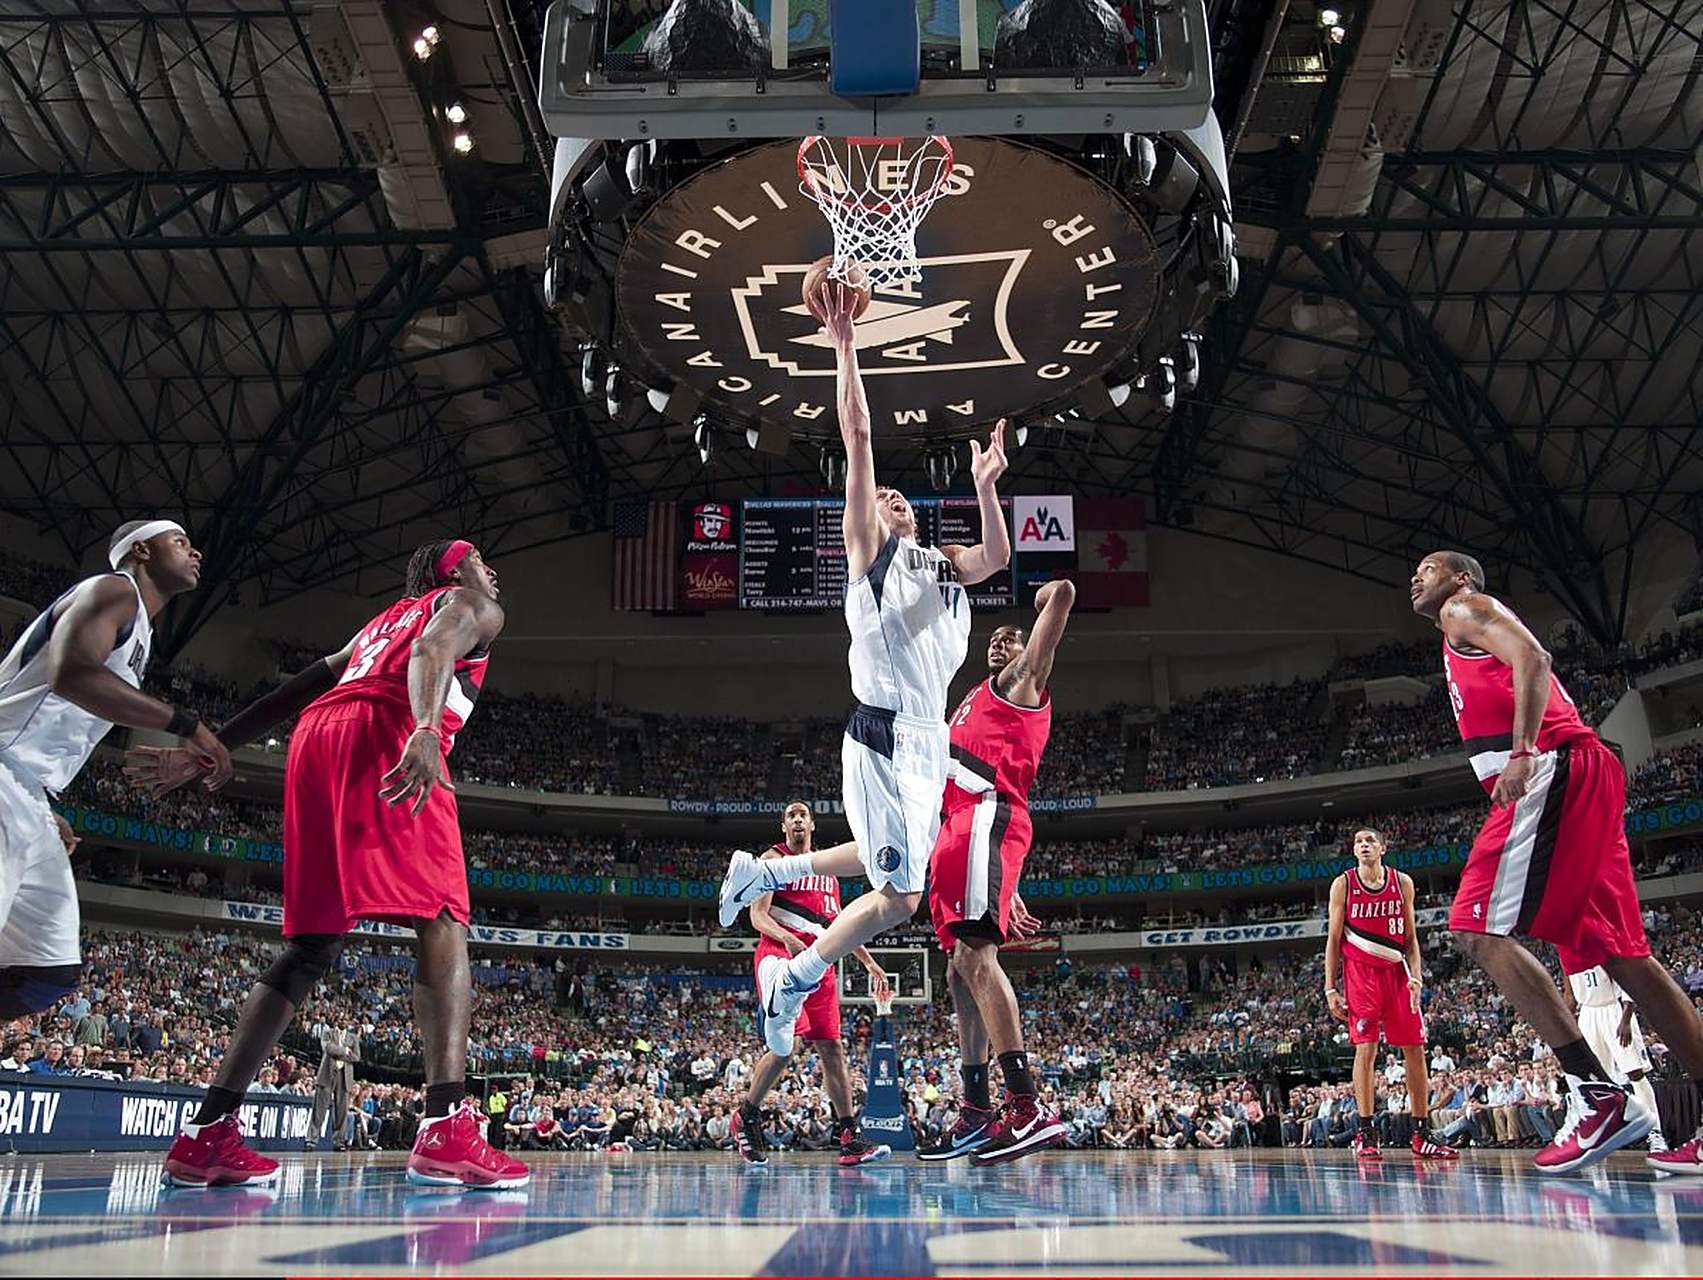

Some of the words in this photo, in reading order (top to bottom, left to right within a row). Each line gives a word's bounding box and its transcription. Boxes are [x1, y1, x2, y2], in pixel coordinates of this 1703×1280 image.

[1036, 213, 1123, 380] CENTER
[750, 599, 769, 607] CALL
[339, 637, 391, 685] 3
[671, 801, 709, 812] ROWDY
[716, 802, 755, 813] PROUD
[1028, 801, 1057, 812] ROUD
[1062, 799, 1093, 811] LOUD
[1351, 900, 1402, 919] BLAZERS
[1146, 931, 1195, 946] GET
[1203, 924, 1304, 942] ROWDY.
[1388, 917, 1405, 936] 88
[536, 931, 626, 949] FANS
[1585, 971, 1599, 988] 31
[29, 1091, 60, 1135] TV
[120, 1096, 175, 1137] WATCH
[259, 1105, 279, 1138] ON
